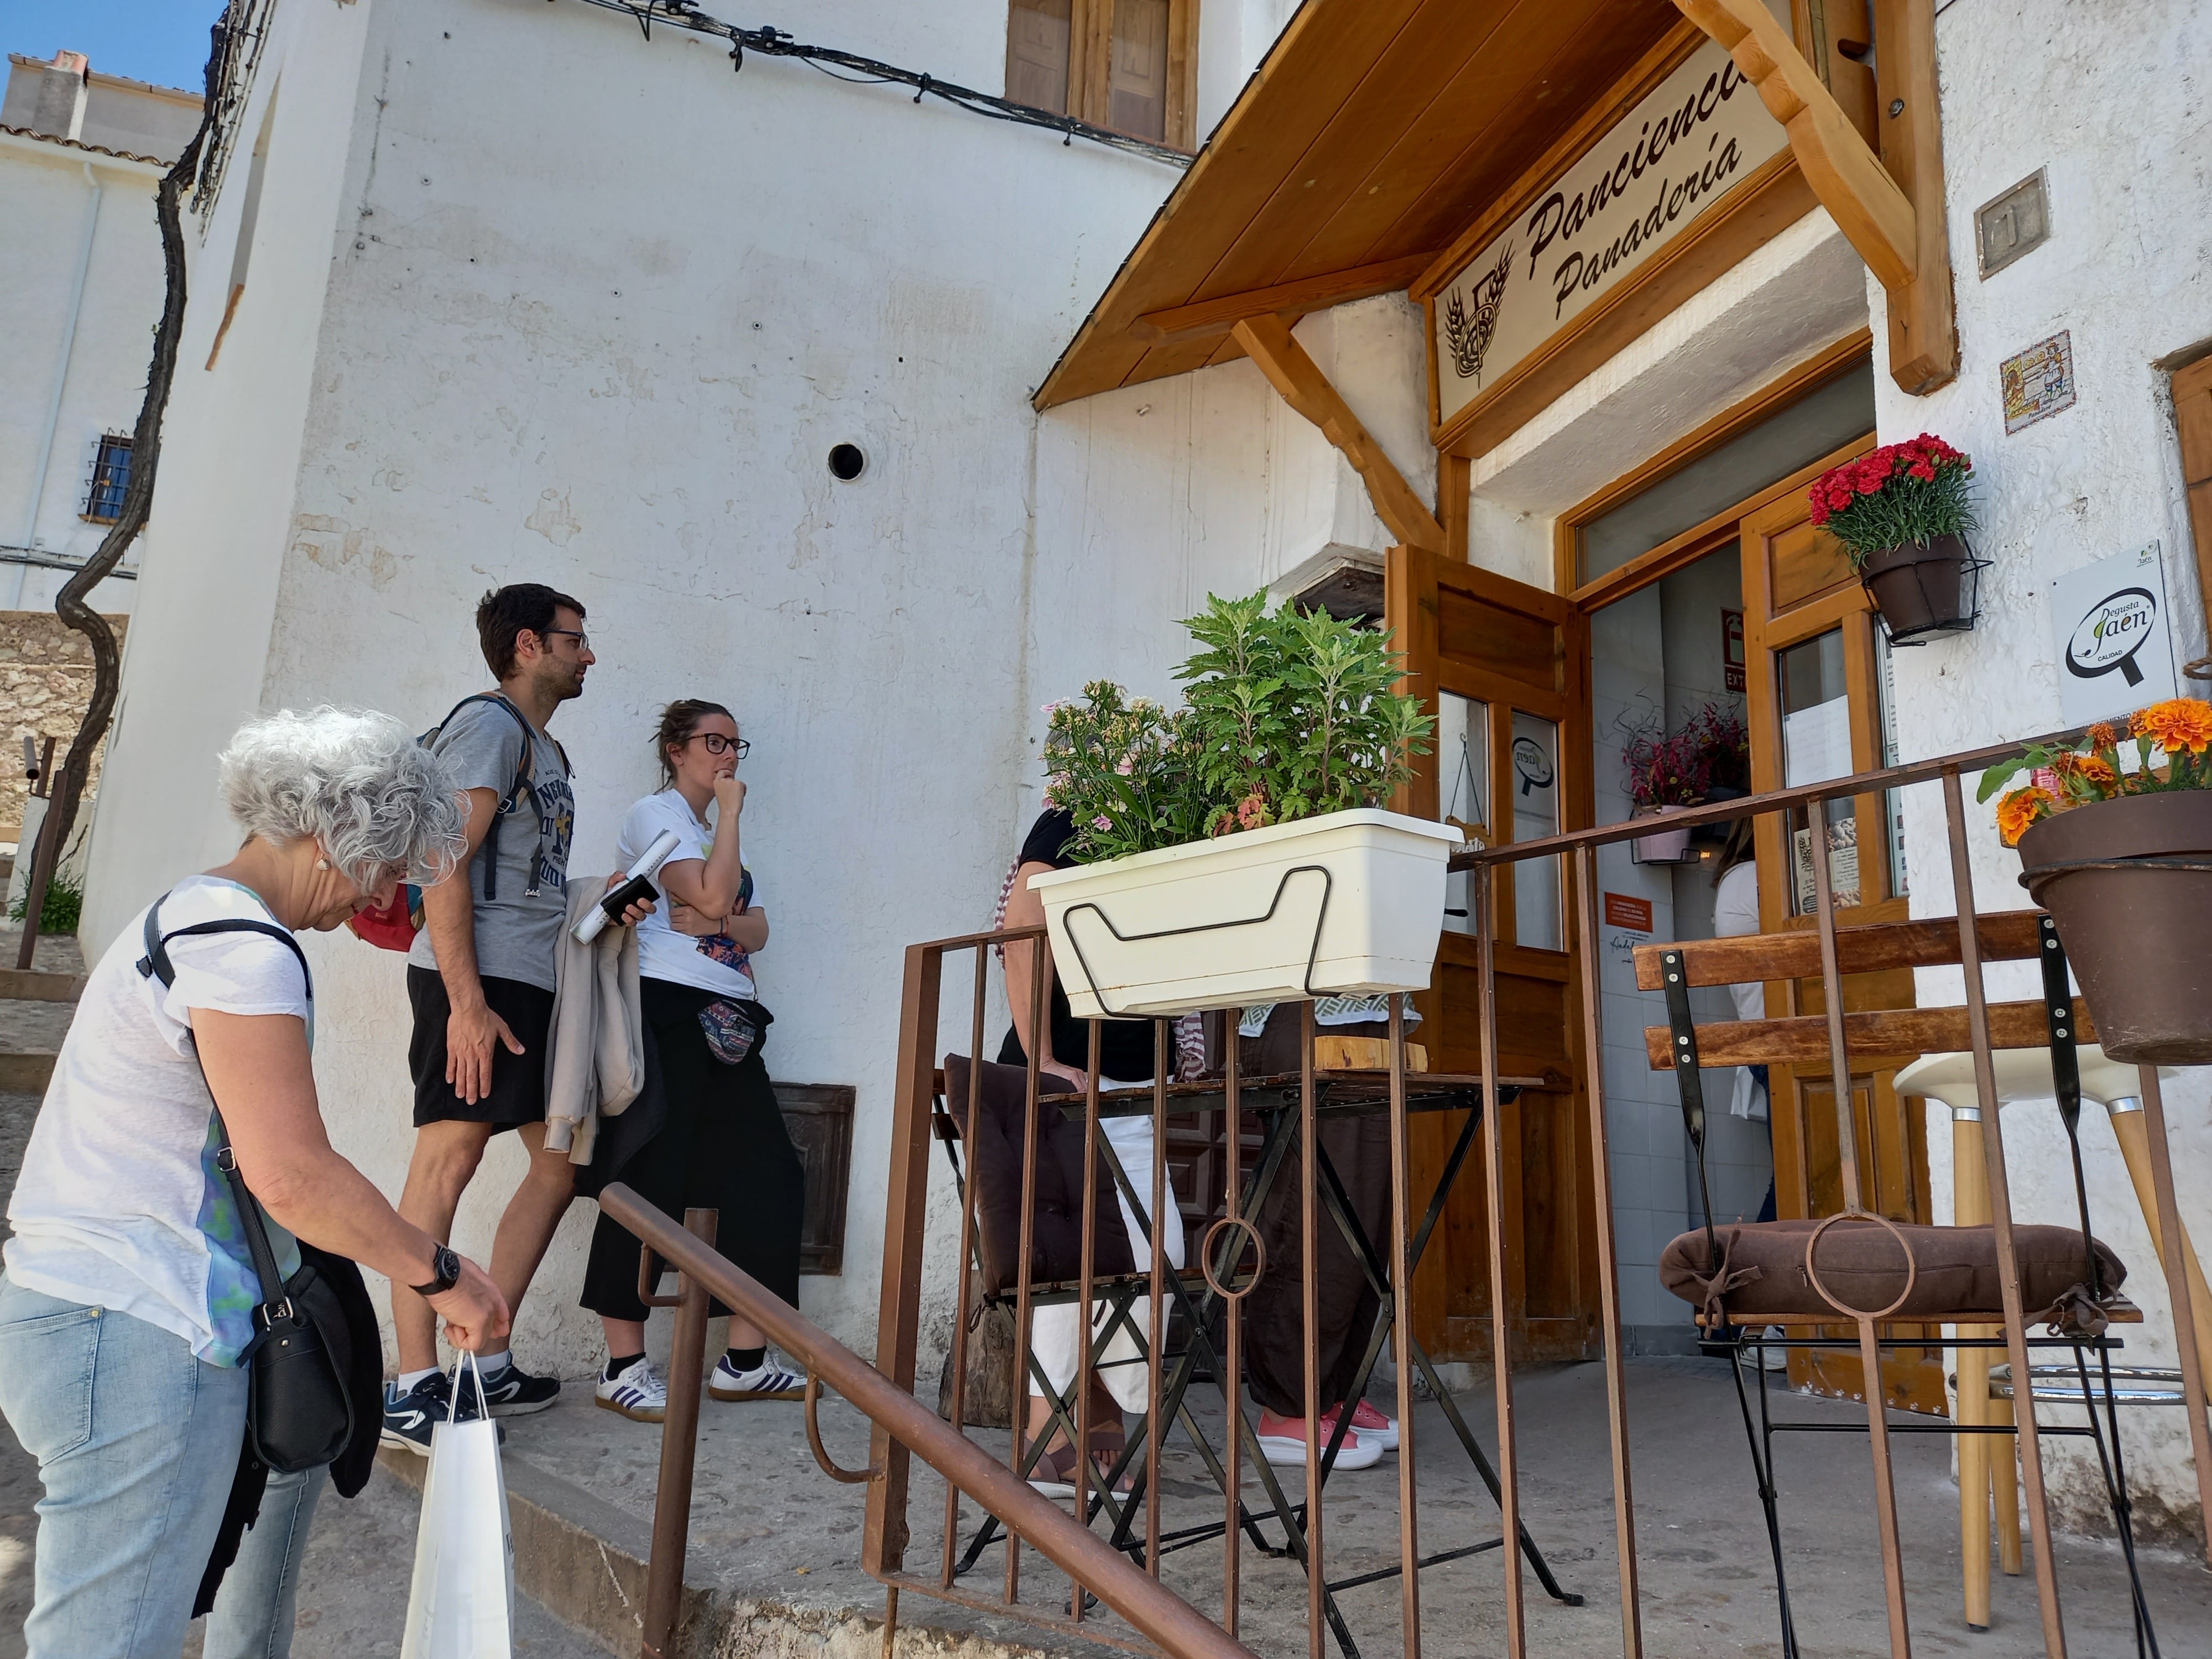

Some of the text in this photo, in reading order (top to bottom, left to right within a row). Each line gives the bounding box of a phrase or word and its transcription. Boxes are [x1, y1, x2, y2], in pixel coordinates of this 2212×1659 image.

[1553, 132, 1743, 321] Panadería
[1998, 205, 2017, 247] 1
[2100, 601, 2139, 621] Degusta
[2090, 611, 2147, 654] Jaén
[2098, 650, 2123, 662] CALIDAD
[1727, 672, 1744, 687] EXT
[552, 855, 566, 868] FIGH
